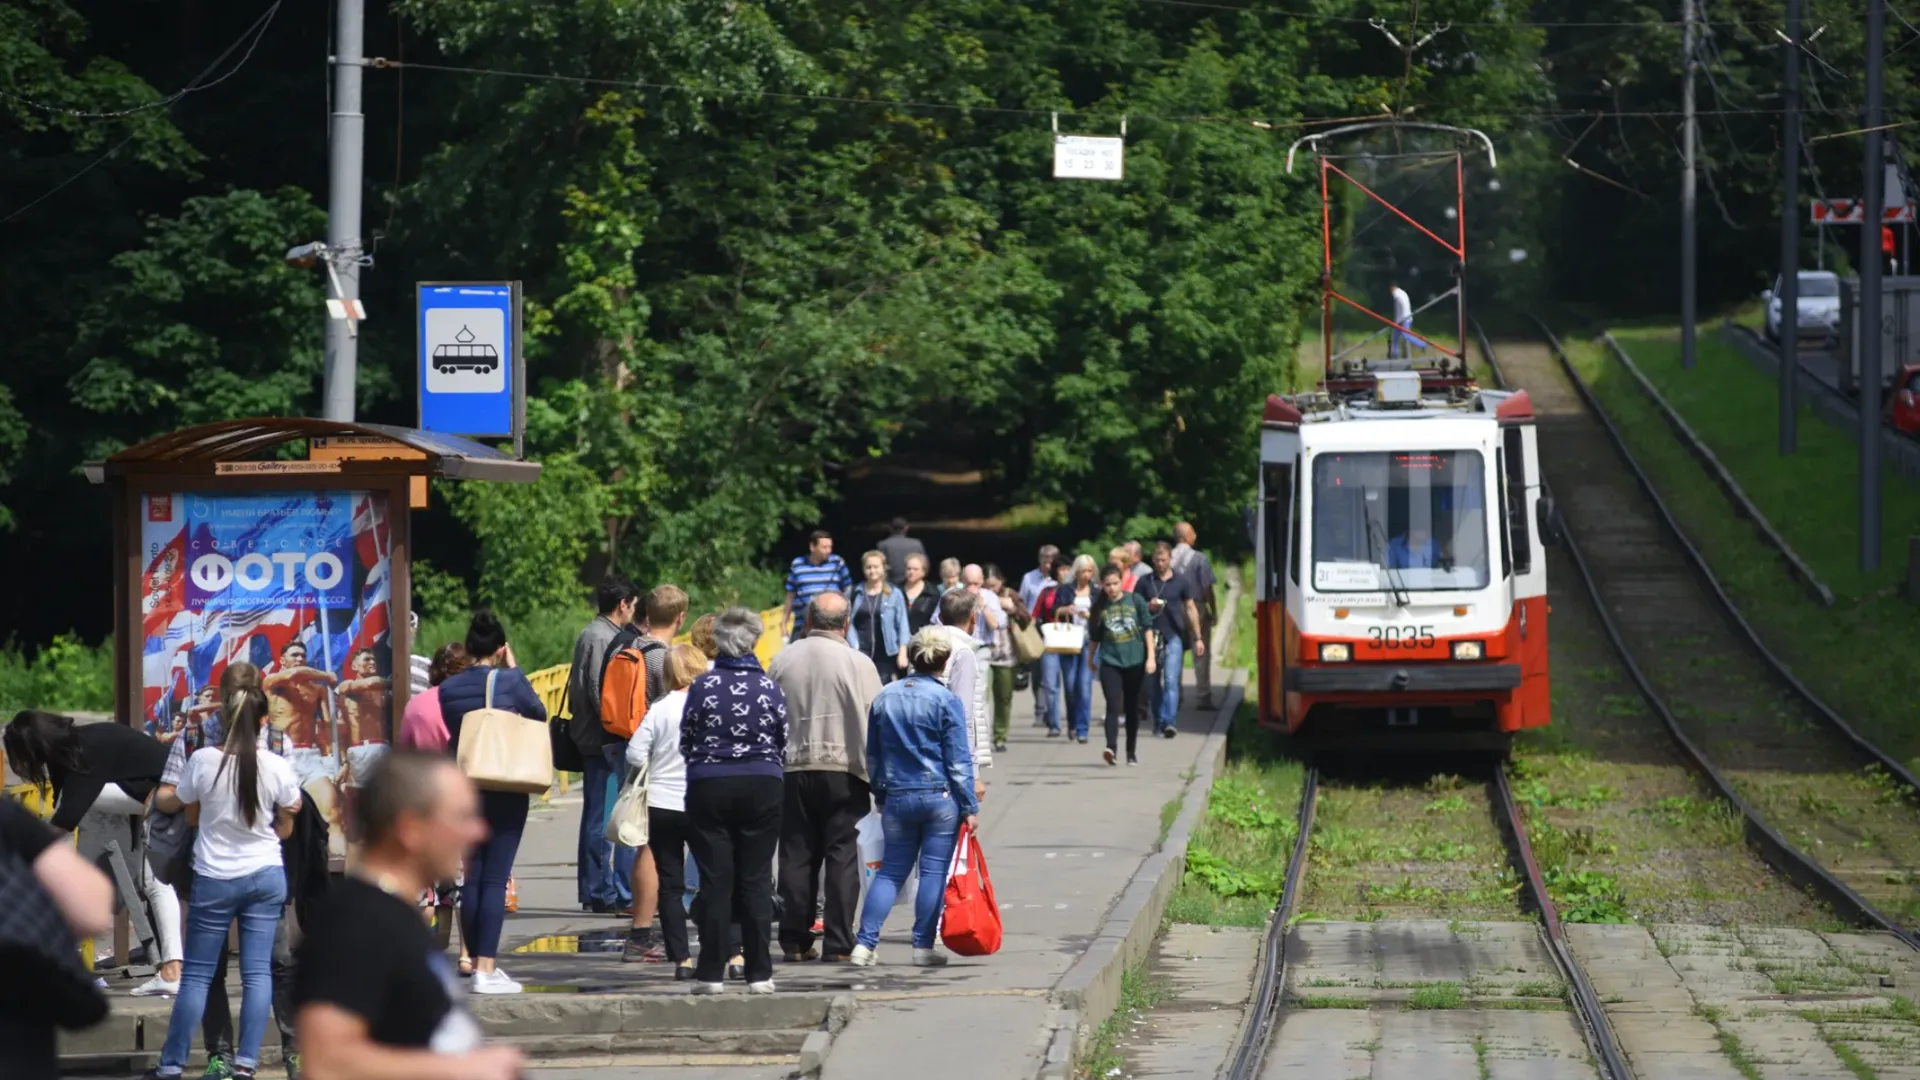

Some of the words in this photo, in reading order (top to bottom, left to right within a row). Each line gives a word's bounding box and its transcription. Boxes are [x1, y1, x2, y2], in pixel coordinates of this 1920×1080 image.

[257, 461, 288, 473] Gallery
[191, 539, 342, 549] СОВЕТСКОЕ
[190, 551, 344, 592] ФОТО
[149, 577, 160, 608] Soviet
[325, 596, 346, 605] СССР
[1368, 624, 1435, 649] 3035
